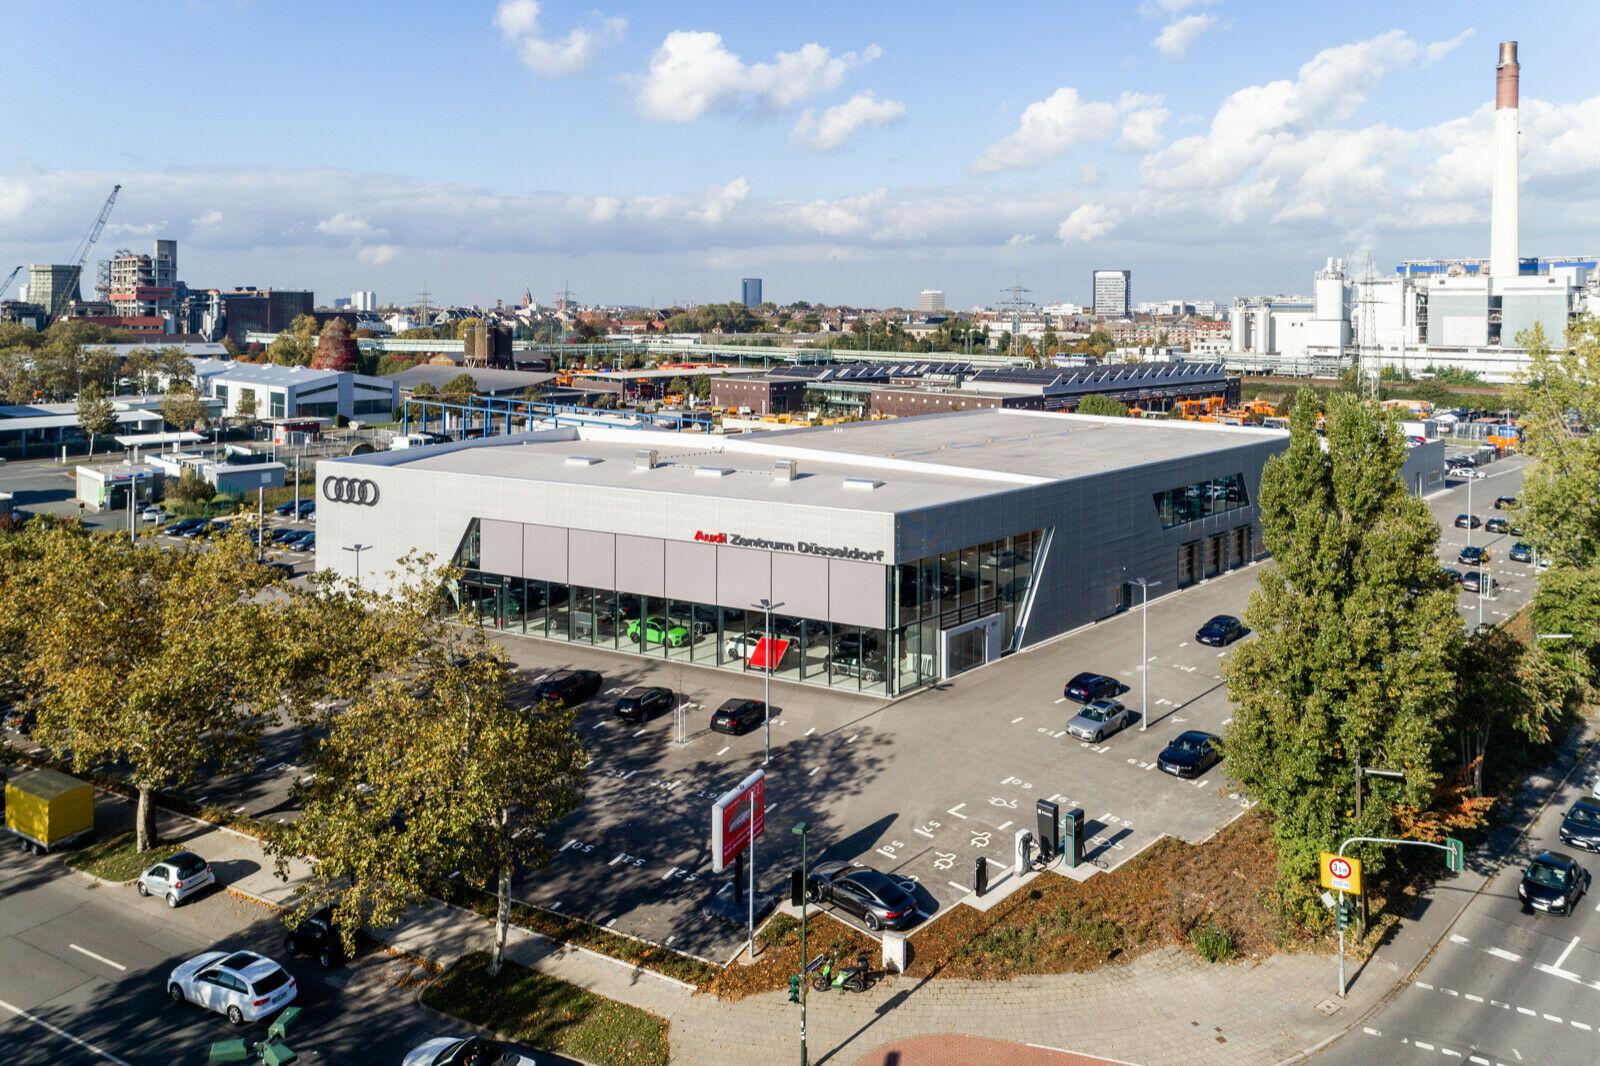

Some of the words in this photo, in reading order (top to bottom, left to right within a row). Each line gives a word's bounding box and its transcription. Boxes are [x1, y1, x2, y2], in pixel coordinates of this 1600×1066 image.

[694, 530, 727, 544] Audi
[730, 534, 795, 552] Zentrum
[798, 541, 885, 562] Düsseldorf
[571, 841, 595, 853] 50
[622, 854, 646, 867] 51
[674, 868, 699, 881] 52
